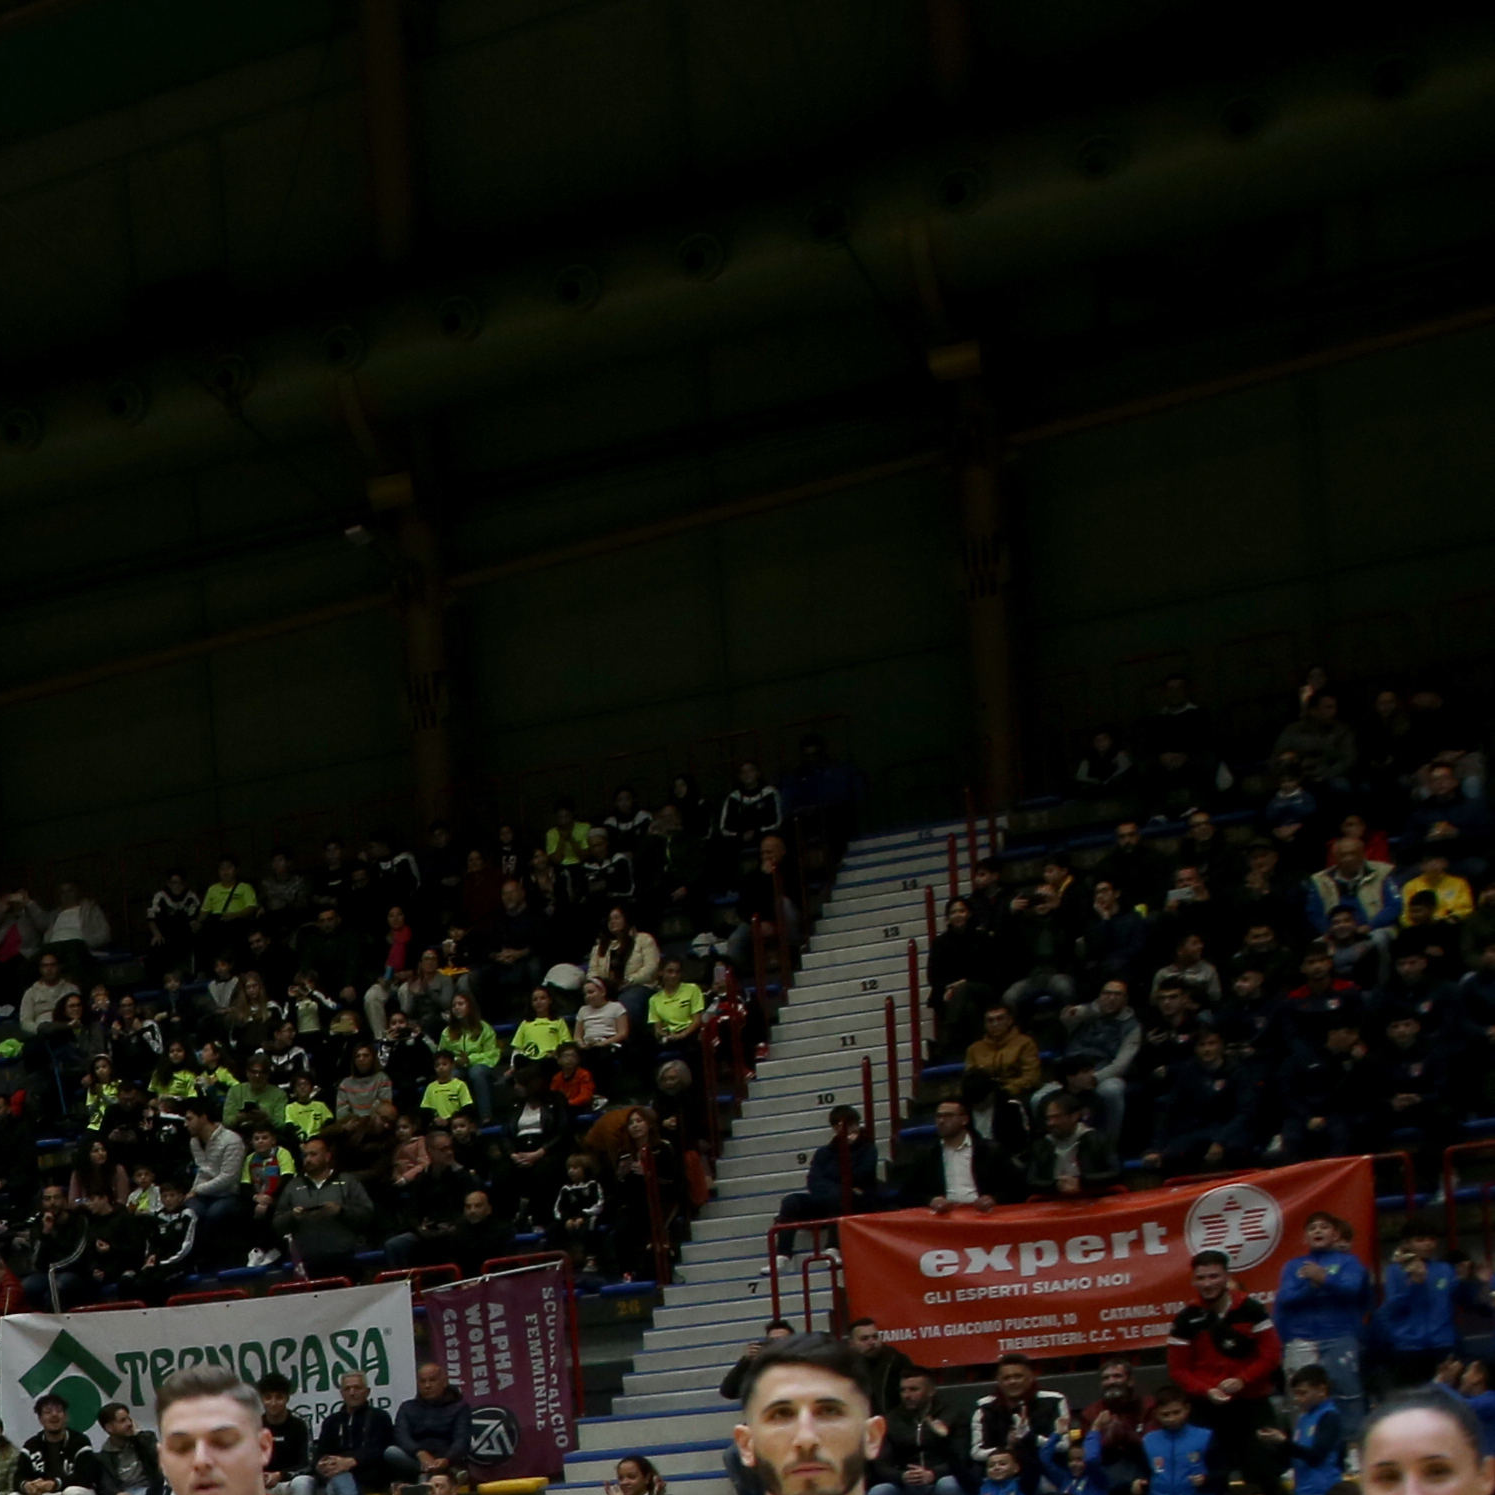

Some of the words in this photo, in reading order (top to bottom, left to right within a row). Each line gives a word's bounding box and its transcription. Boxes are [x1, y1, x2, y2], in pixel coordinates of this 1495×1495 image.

[883, 927, 900, 937] 13
[861, 980, 878, 990] 12
[841, 1036, 856, 1046] 11
[817, 1093, 834, 1104] 10
[798, 1153, 806, 1164] 9
[919, 1222, 1168, 1278] expert
[748, 1283, 758, 1294] 7
[924, 1291, 952, 1304] GLI
[957, 1282, 1028, 1301] ESPERTI
[1033, 1277, 1092, 1295] SIAMO
[1097, 1272, 1131, 1288] NOI
[1100, 1306, 1160, 1323] CATANIA:
[920, 1324, 941, 1340] VIA
[944, 1320, 1002, 1337] GIACOMO
[1006, 1315, 1061, 1332] PUCCINI,
[1064, 1313, 1078, 1326] 10
[465, 1302, 491, 1397] WOMEN
[487, 1302, 515, 1391] ALPHA
[998, 1332, 1087, 1351] TREMESTIERI:
